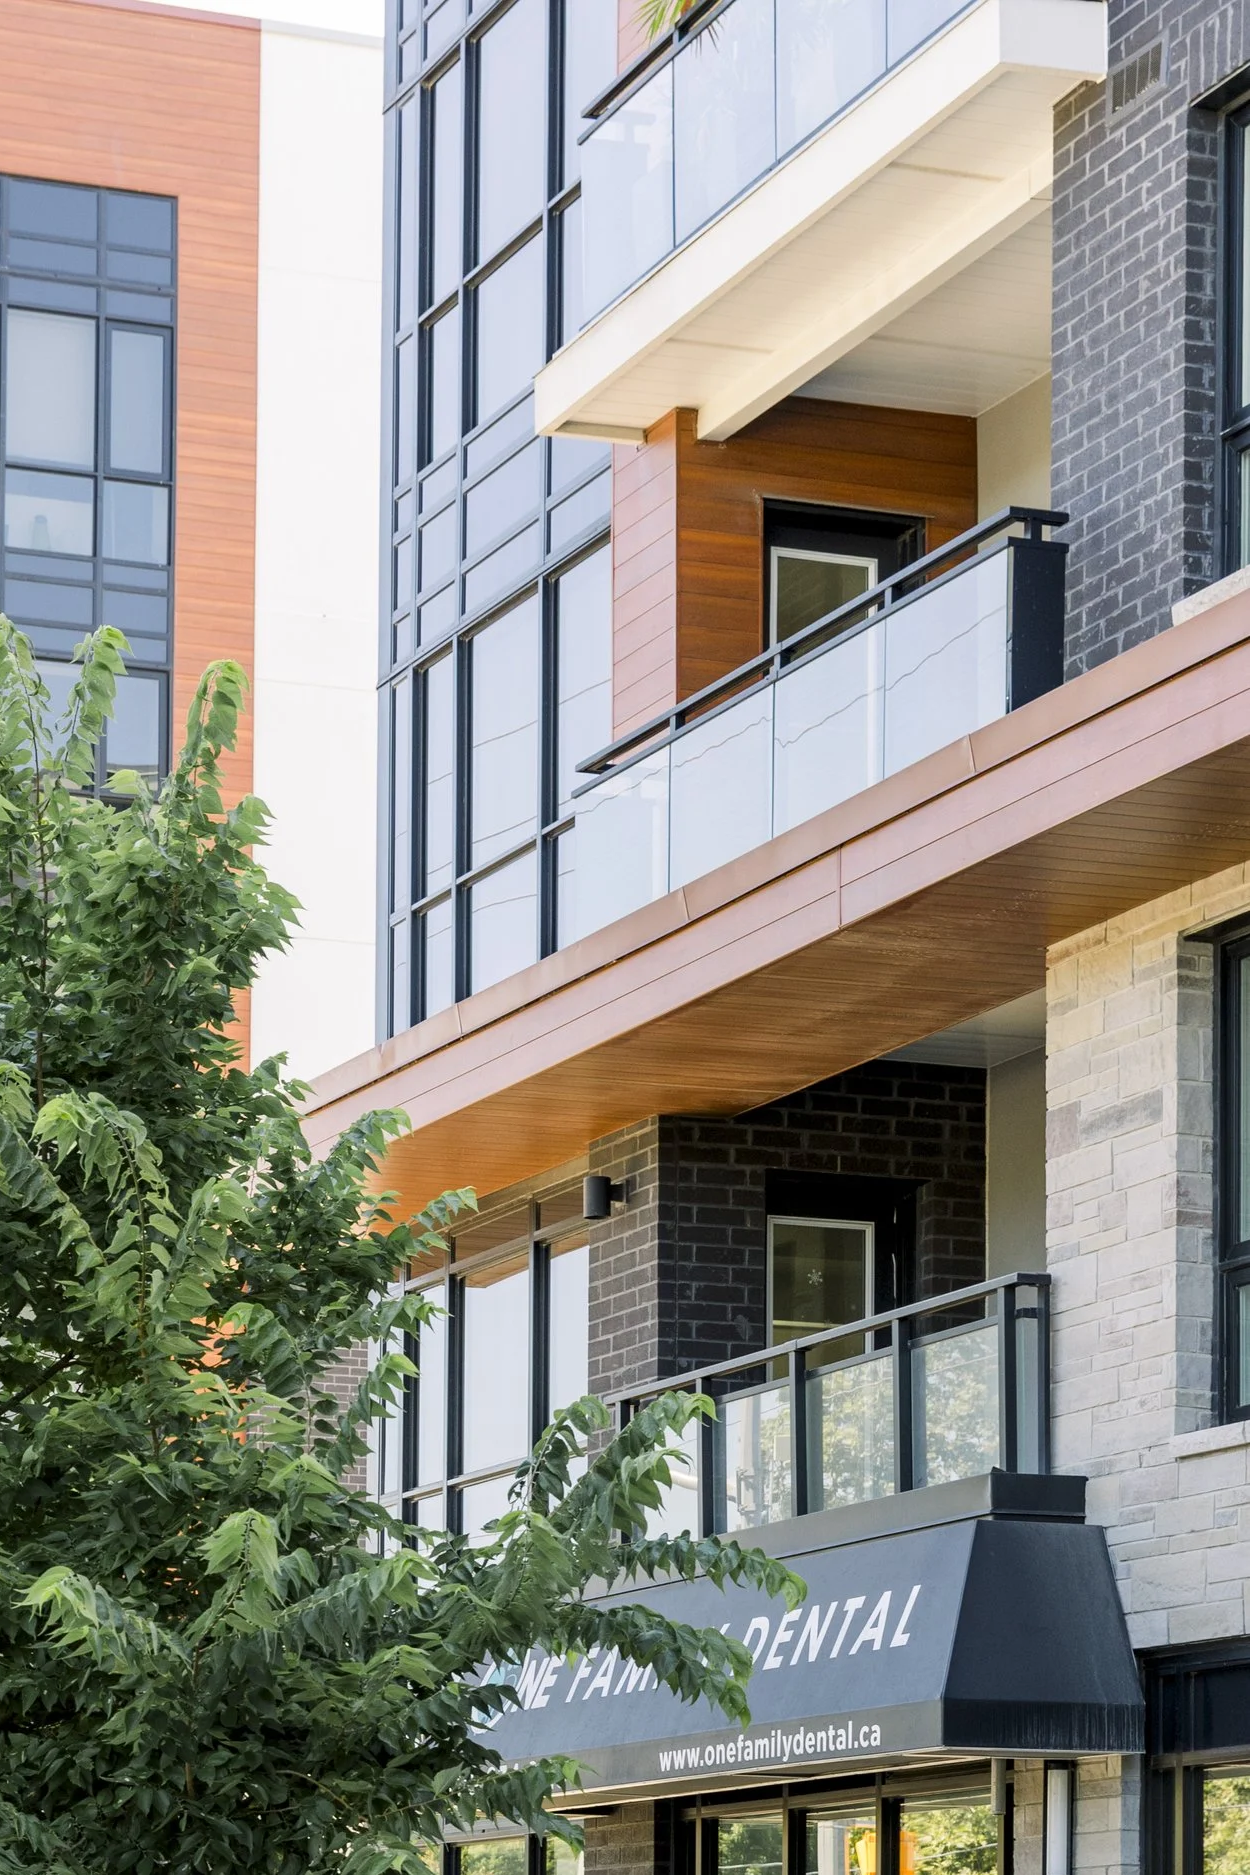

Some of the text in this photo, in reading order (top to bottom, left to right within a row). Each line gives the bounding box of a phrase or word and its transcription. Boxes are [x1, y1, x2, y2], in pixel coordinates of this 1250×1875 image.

[565, 1623, 731, 1703] FAM
[729, 1584, 921, 1677] DENTAL
[659, 1721, 881, 1772] www.onefamilydental.ca
